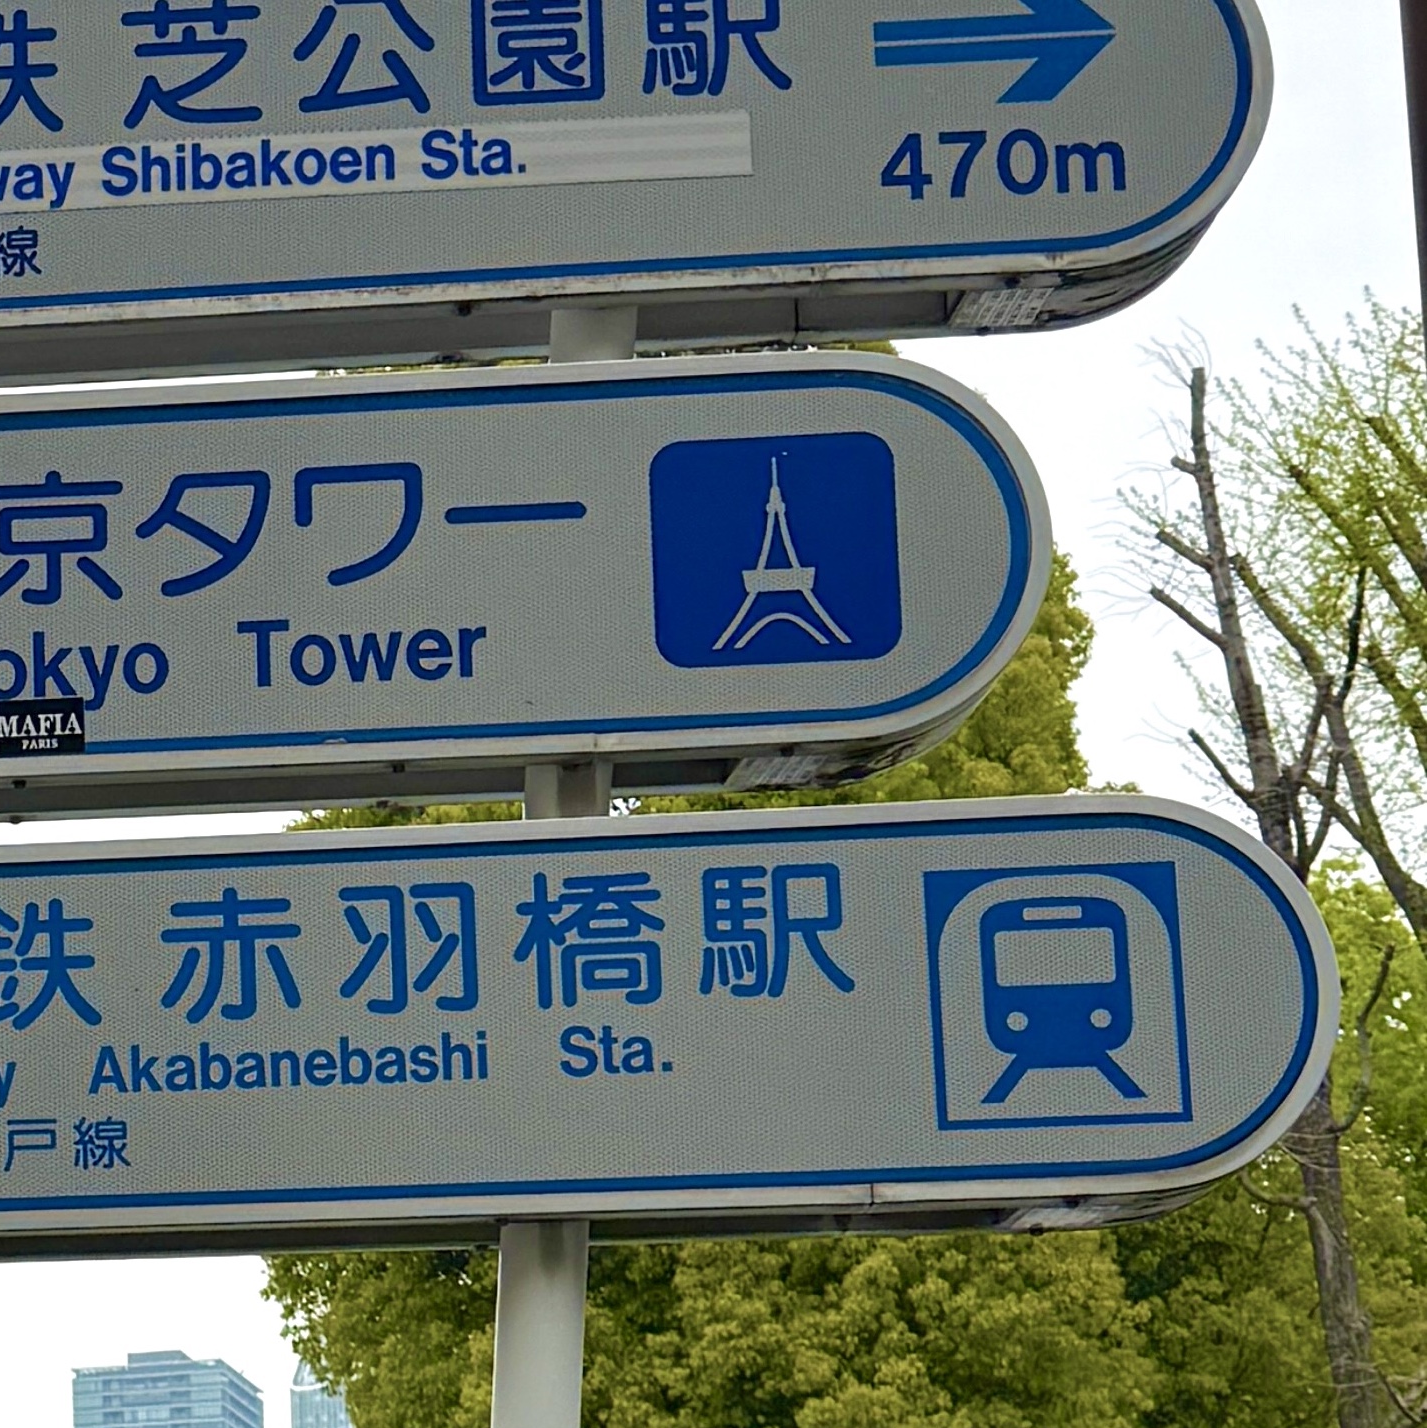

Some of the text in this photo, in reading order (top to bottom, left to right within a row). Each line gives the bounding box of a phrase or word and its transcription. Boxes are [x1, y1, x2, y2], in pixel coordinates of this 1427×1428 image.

[102, 138, 395, 197] Shibakoen
[421, 128, 527, 179] Sta.
[881, 128, 1127, 201] 470m
[237, 619, 487, 689] Tower
[21, 738, 59, 750] PARIS
[89, 1030, 488, 1095] Akabanebashi
[559, 1025, 673, 1078] Sta.
